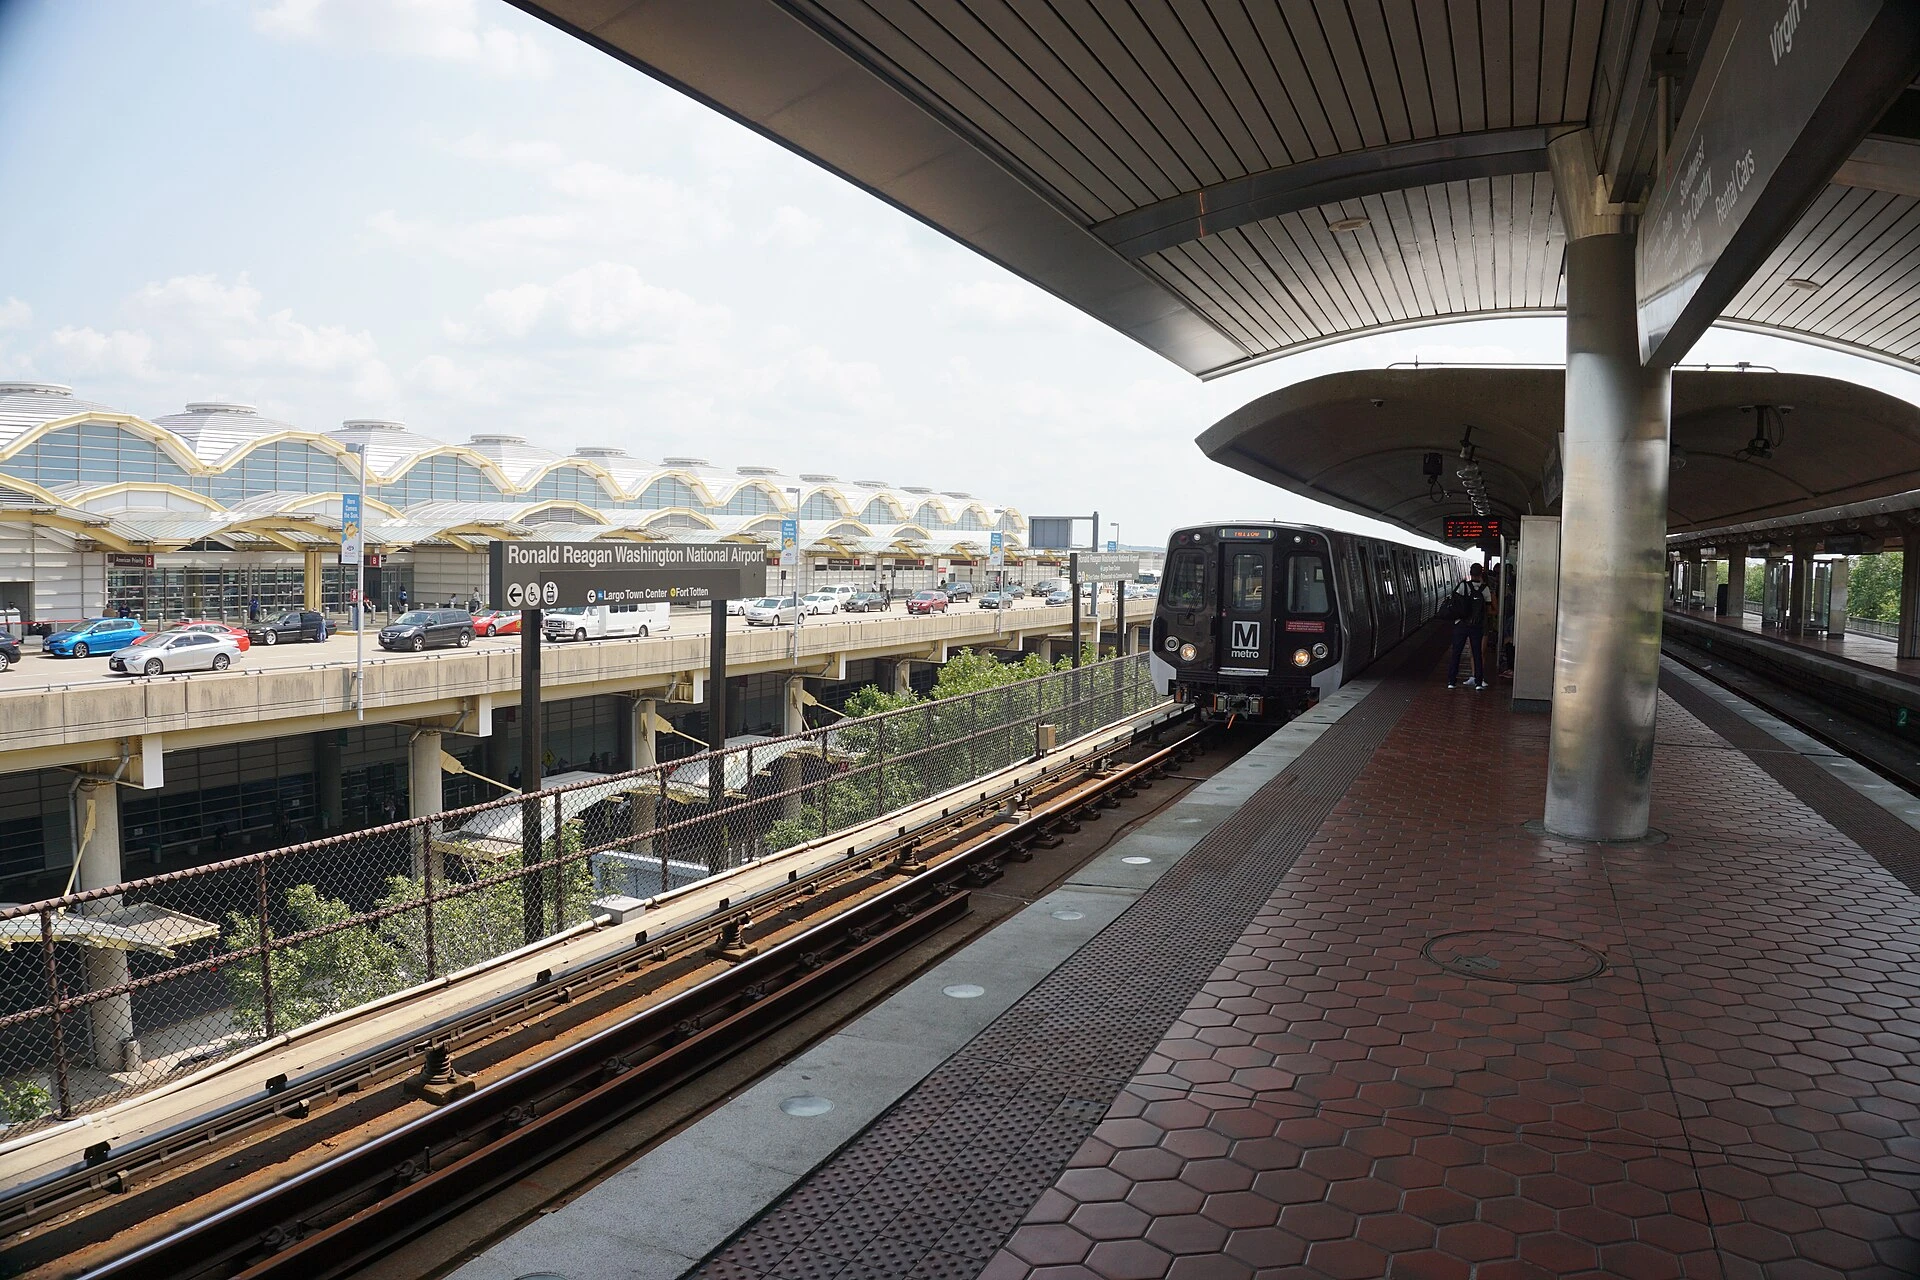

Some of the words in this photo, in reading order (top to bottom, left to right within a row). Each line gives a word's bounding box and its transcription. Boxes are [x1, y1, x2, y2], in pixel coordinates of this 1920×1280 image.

[1769, 0, 1801, 66] Virgin
[1715, 170, 1738, 226] Rental
[1735, 148, 1755, 192] Cars
[1681, 209, 1692, 239] Sun
[1691, 166, 1712, 221] Country
[147, 557, 152, 566] B
[508, 545, 559, 564] Ronald
[563, 545, 612, 568] Reagan
[615, 545, 683, 567] Washington
[686, 546, 728, 562] National
[731, 547, 764, 566] Airport
[603, 590, 625, 602] Largo
[625, 589, 644, 599] Town
[645, 588, 668, 599] Center
[676, 587, 690, 597] Fort
[689, 587, 709, 596] Totten
[1233, 622, 1259, 648] M
[1231, 650, 1259, 659] metro
[1899, 710, 1907, 724] 2
